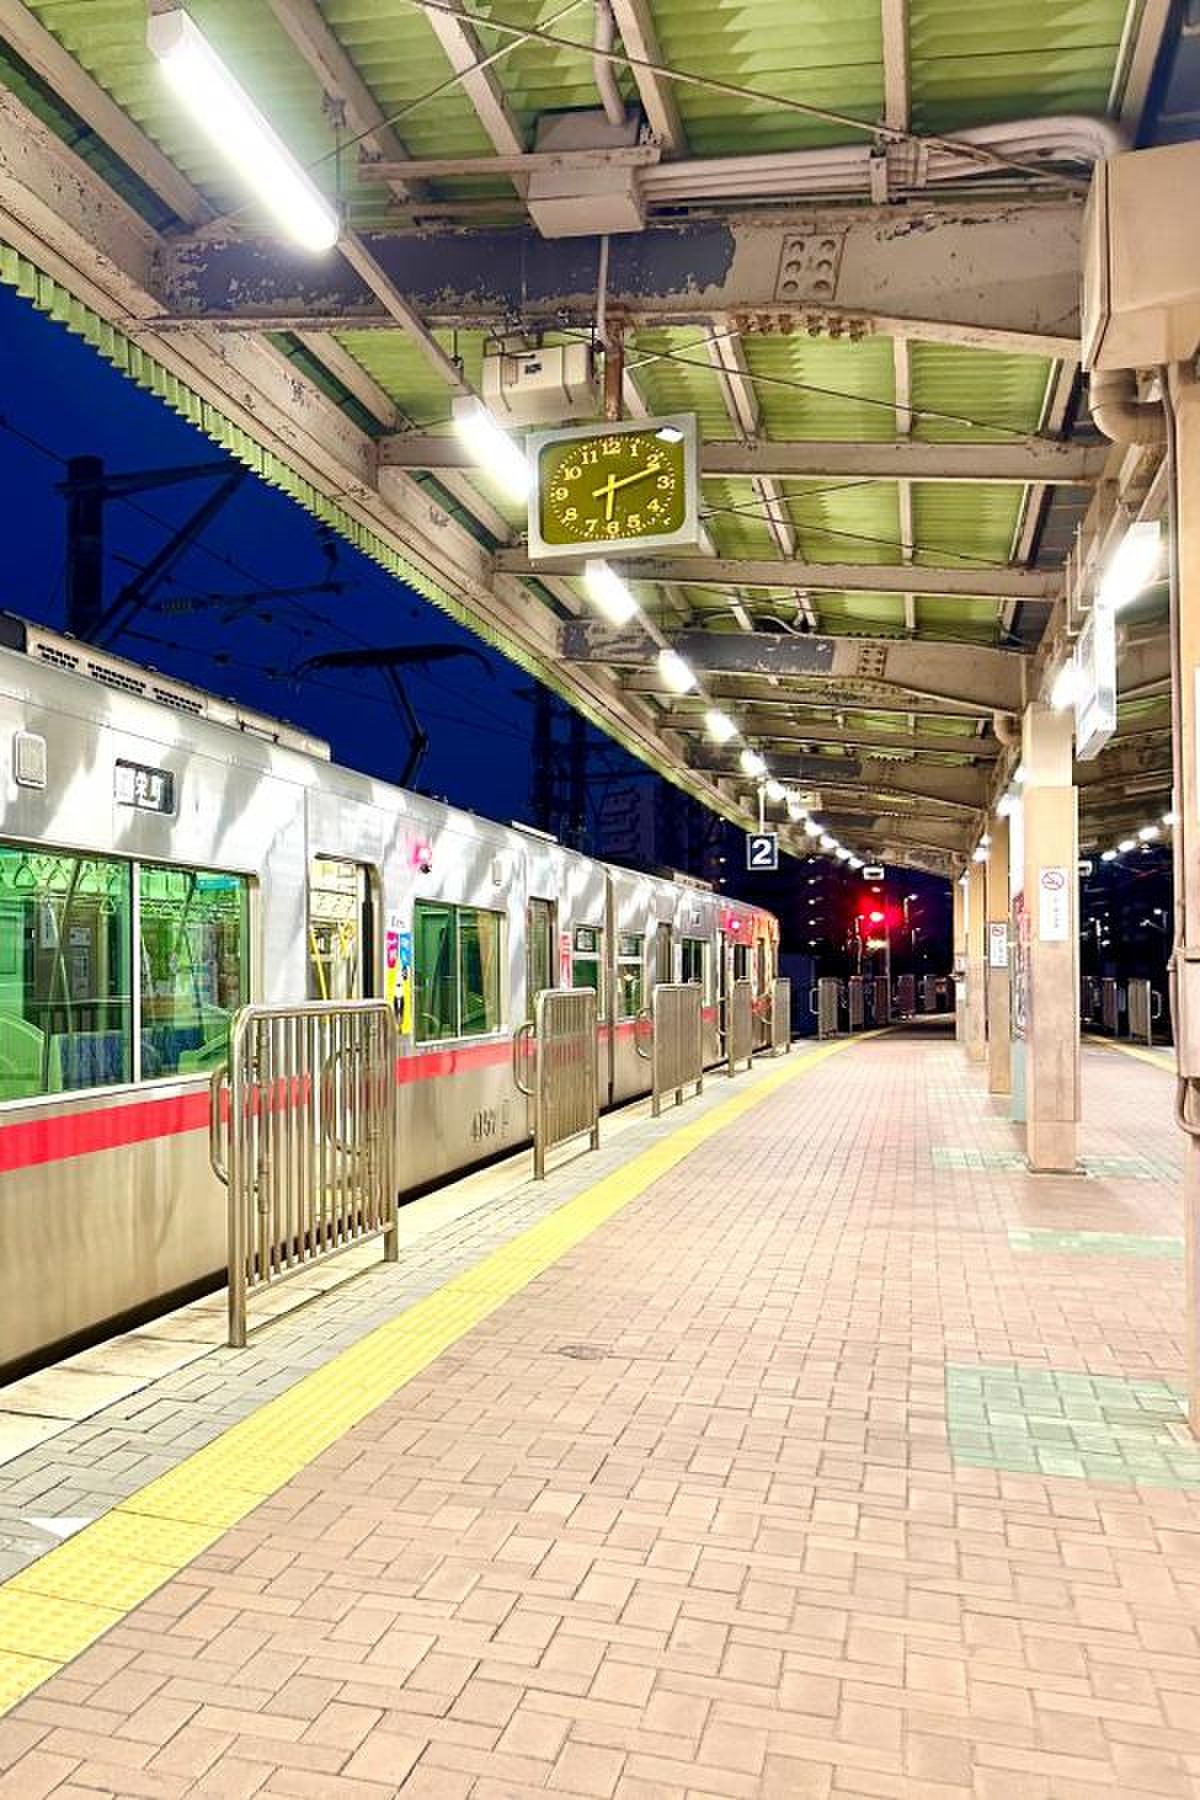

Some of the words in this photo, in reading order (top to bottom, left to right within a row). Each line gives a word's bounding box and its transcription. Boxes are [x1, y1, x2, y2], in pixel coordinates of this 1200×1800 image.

[601, 441, 621, 455] 12
[630, 444, 638, 457] 1
[581, 450, 598, 465] 11
[647, 454, 660, 468] 2
[563, 466, 582, 481] 10
[657, 476, 670, 489] 3
[556, 487, 569, 501] 9
[647, 499, 661, 512] 4
[565, 508, 578, 521] 8
[627, 514, 640, 528] 5
[585, 519, 599, 533] 7
[607, 521, 619, 534] 6
[751, 839, 772, 865] 2
